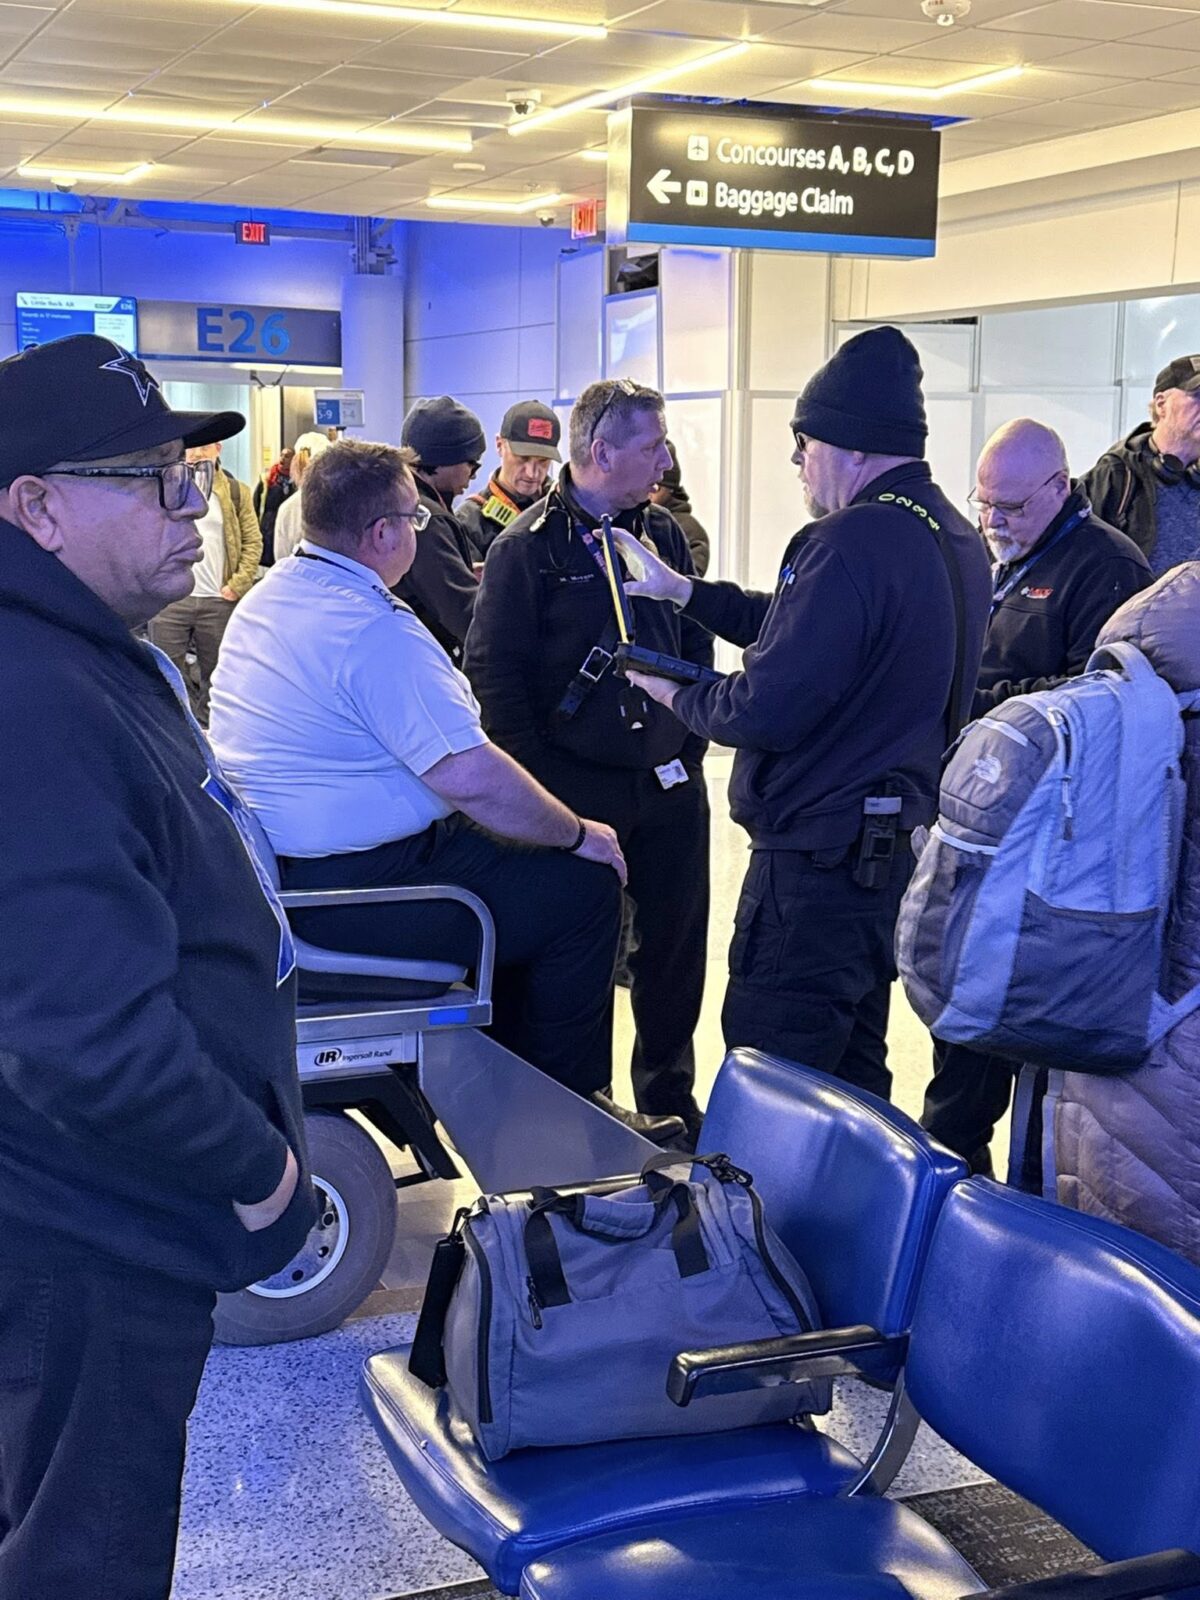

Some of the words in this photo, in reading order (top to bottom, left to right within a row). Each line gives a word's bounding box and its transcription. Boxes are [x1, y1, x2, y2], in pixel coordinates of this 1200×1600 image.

[716, 137, 826, 170] Concourses
[715, 181, 799, 217] Baggage
[801, 187, 854, 215] Claim
[242, 222, 266, 242] EXIT
[197, 308, 291, 356] E26
[342, 1052, 372, 1062] Ingersoll
[373, 1049, 393, 1057] Rand
